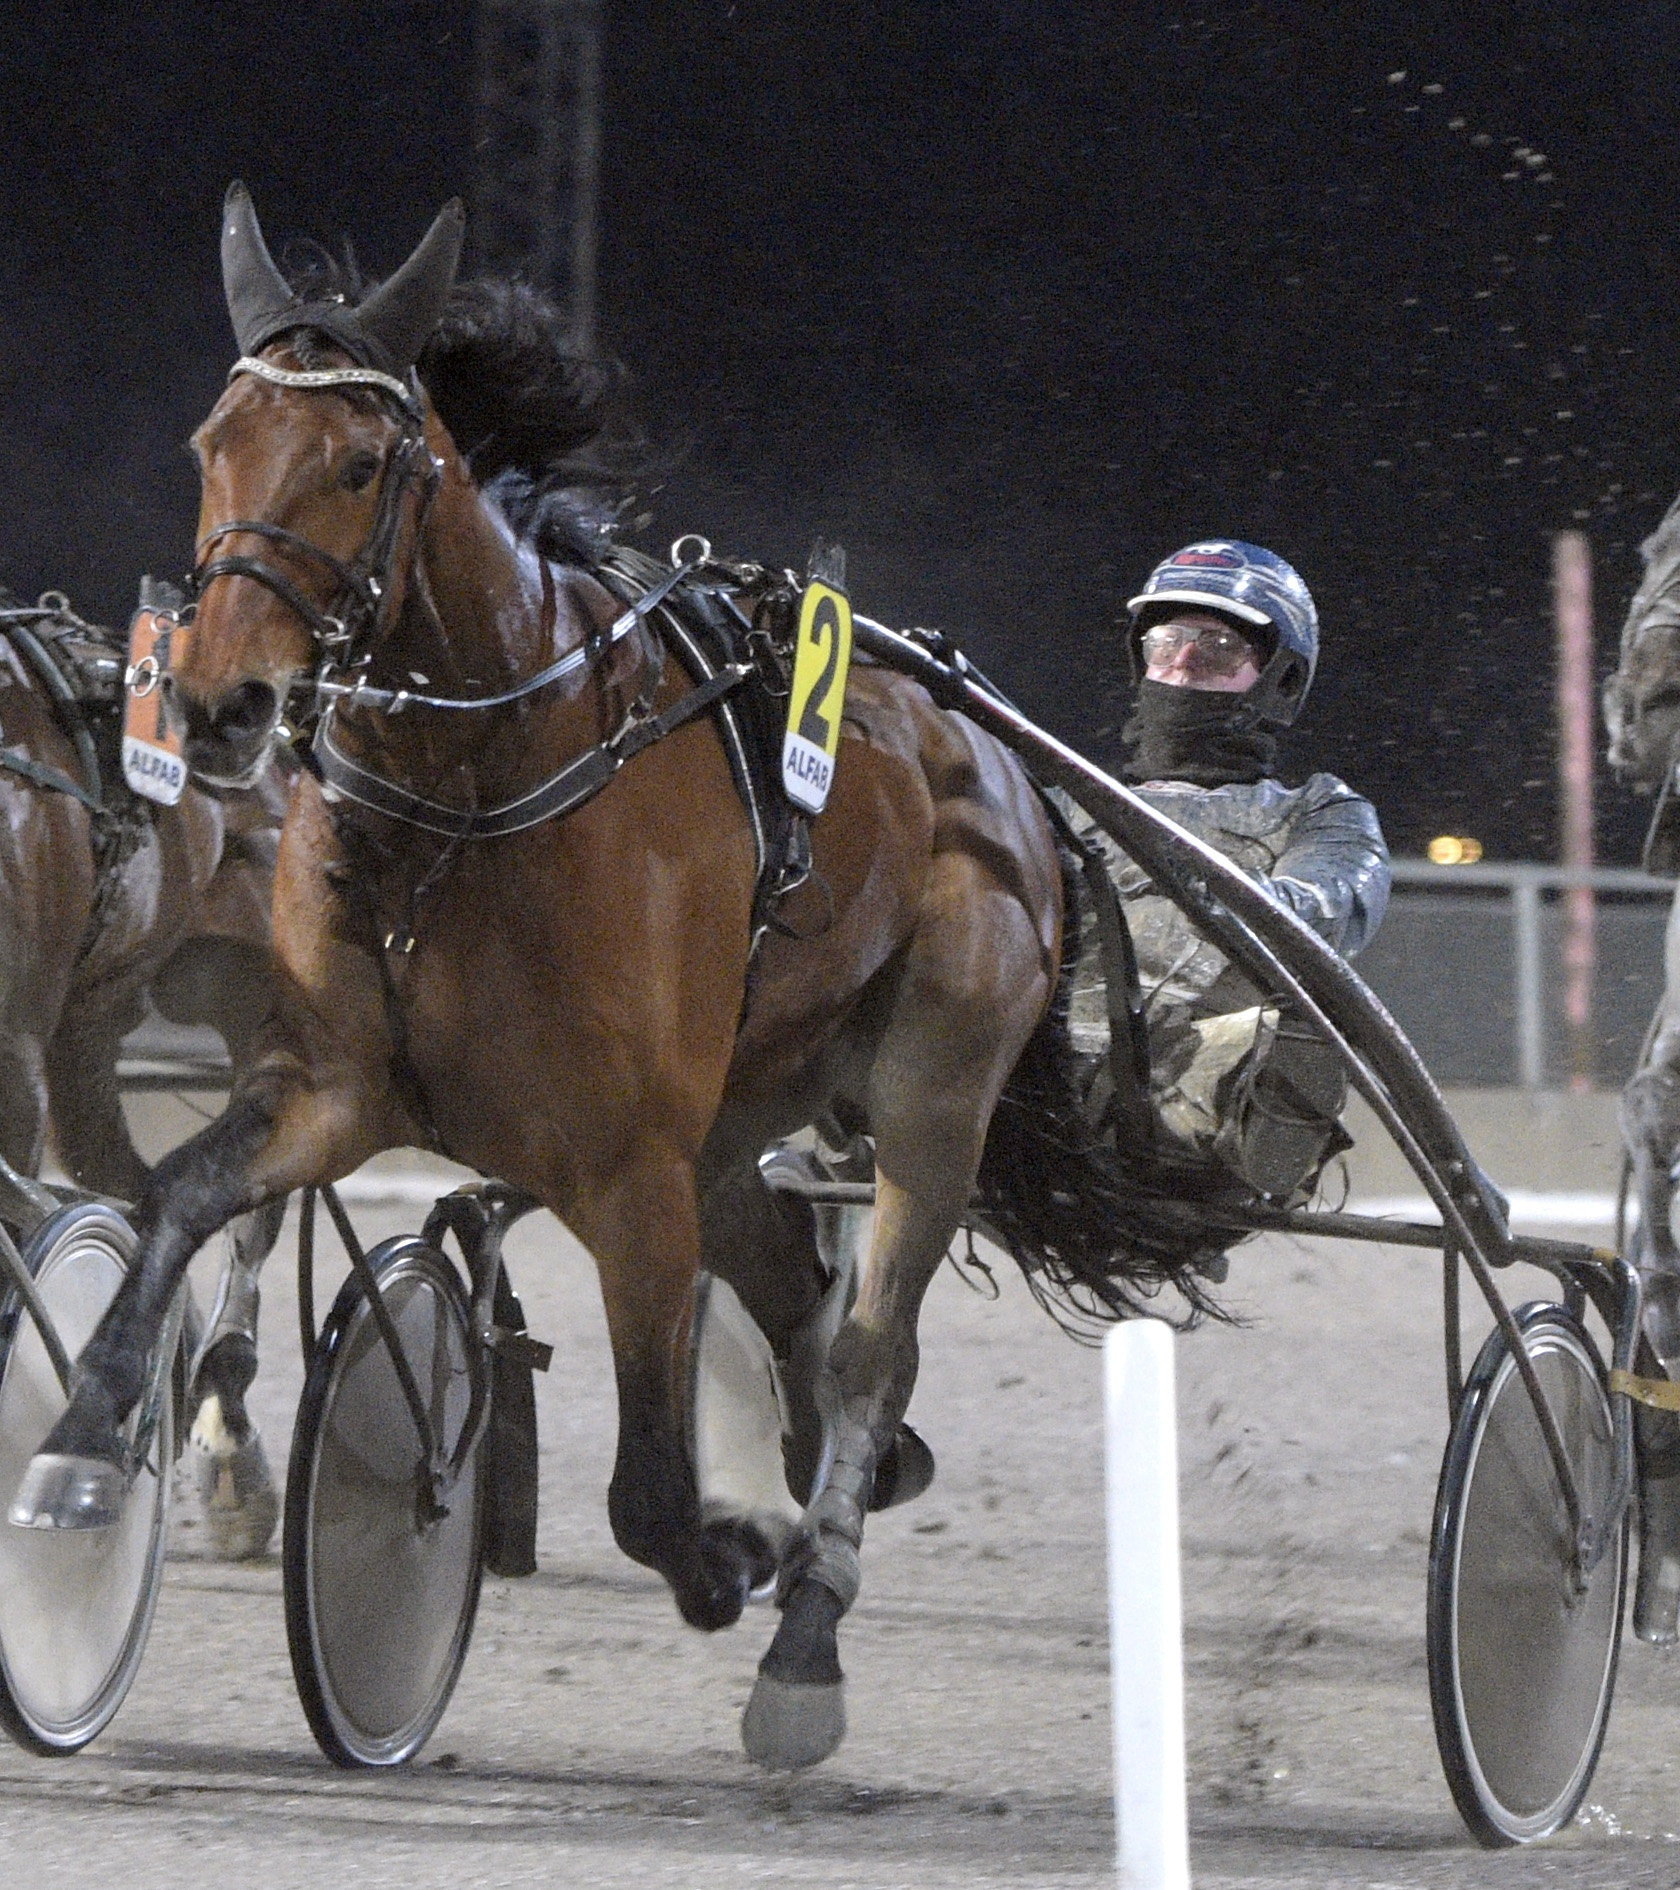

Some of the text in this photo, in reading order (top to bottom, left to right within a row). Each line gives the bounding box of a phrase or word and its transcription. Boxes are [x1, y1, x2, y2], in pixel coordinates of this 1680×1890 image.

[798, 595, 841, 751] 2
[129, 748, 182, 788] ALFAB
[786, 746, 831, 793] ALFAB
